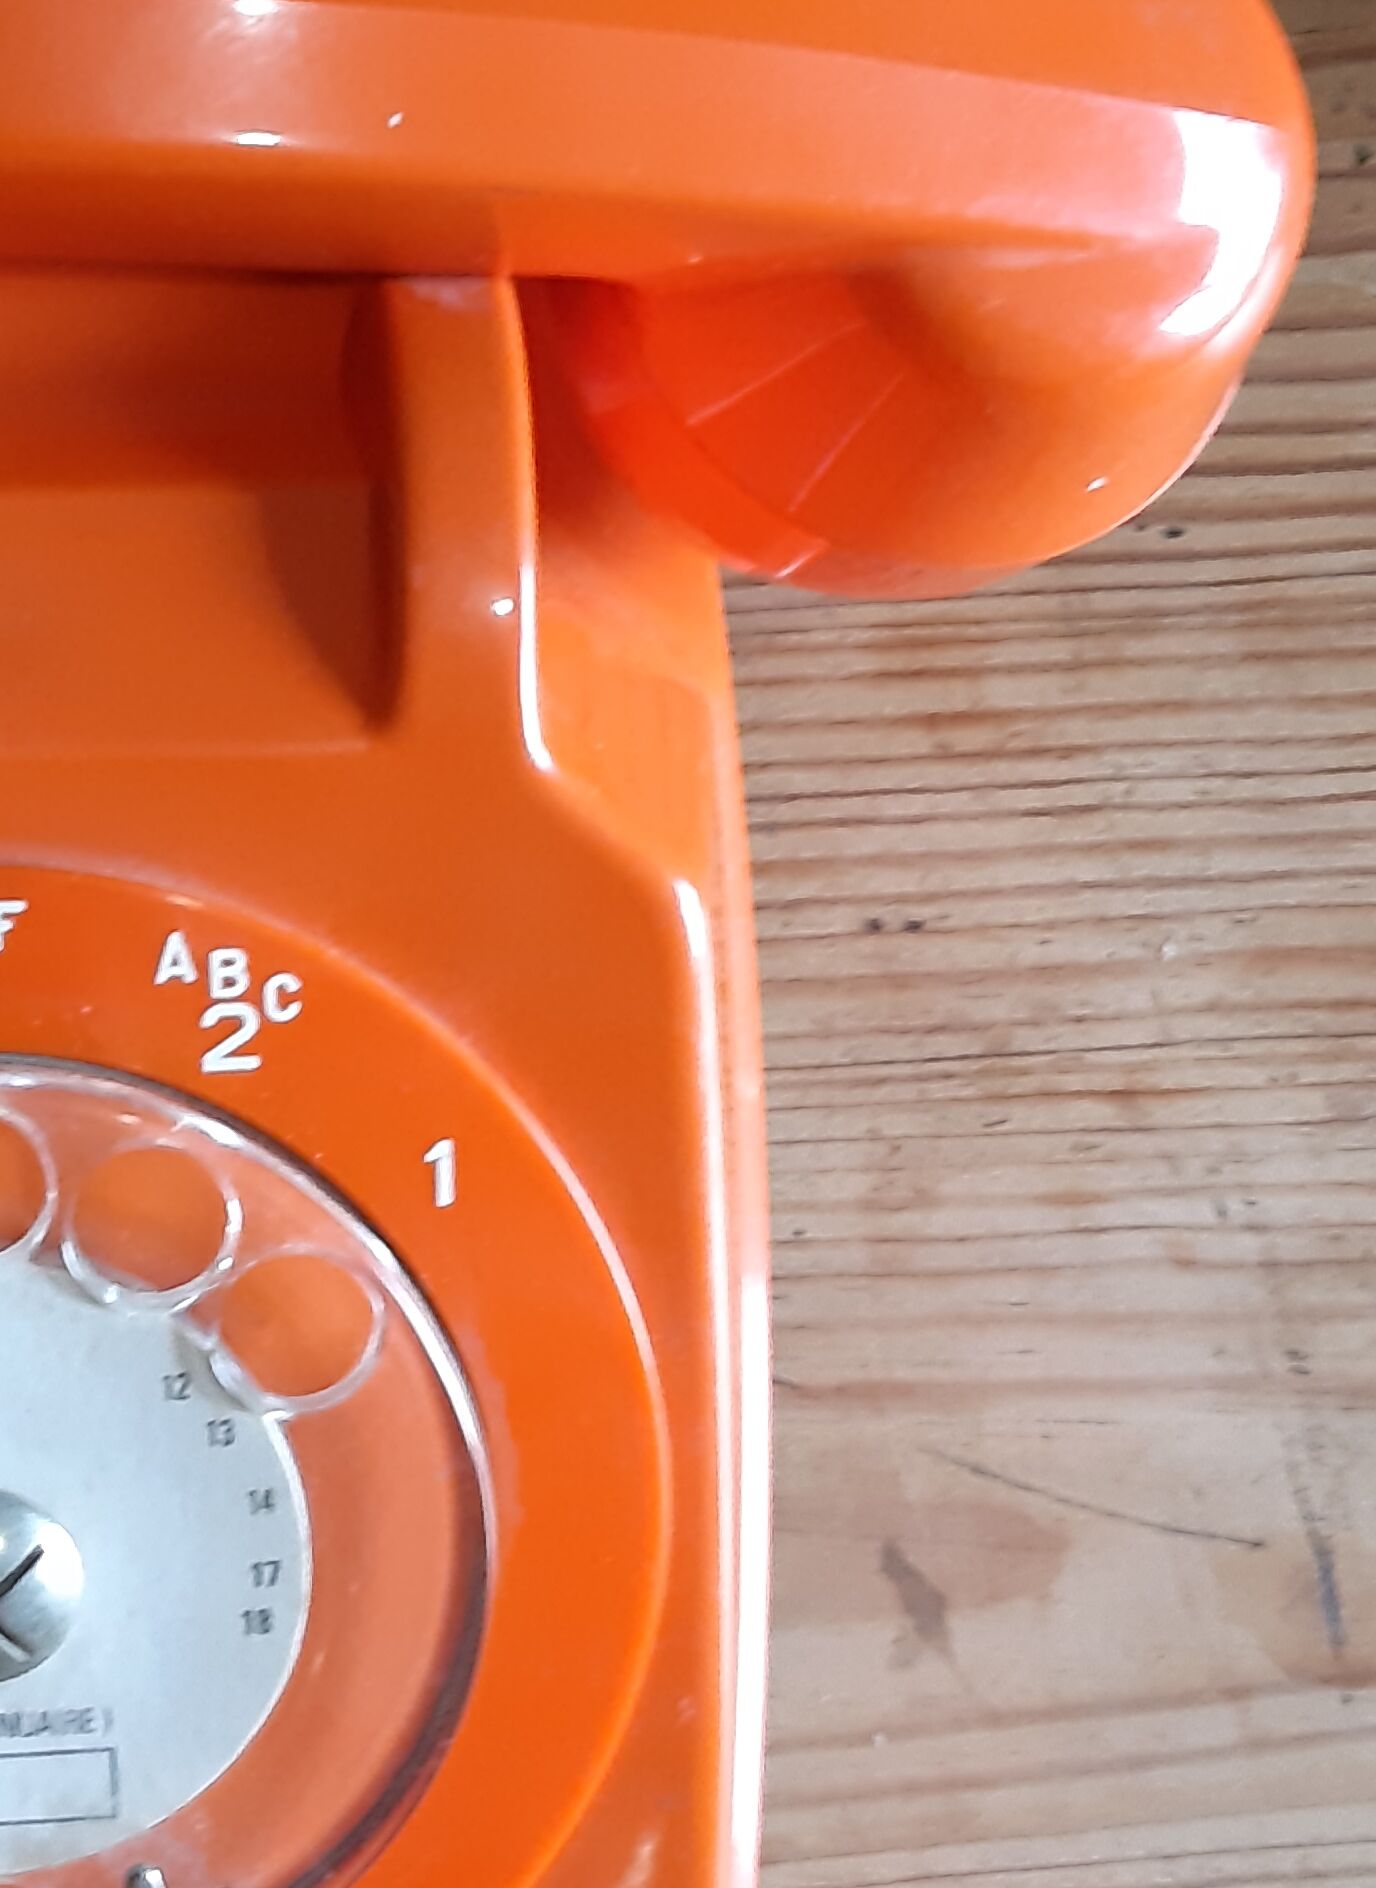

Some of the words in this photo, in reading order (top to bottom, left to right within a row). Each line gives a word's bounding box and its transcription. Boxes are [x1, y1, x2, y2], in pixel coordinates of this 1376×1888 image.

[153, 929, 304, 1024] ABC
[198, 1000, 263, 1074] 2
[422, 1138, 457, 1208] 1
[162, 1372, 191, 1401] 12
[206, 1418, 236, 1448] 13
[247, 1488, 275, 1516] 14
[250, 1560, 282, 1587] 17
[241, 1608, 272, 1636] 18
